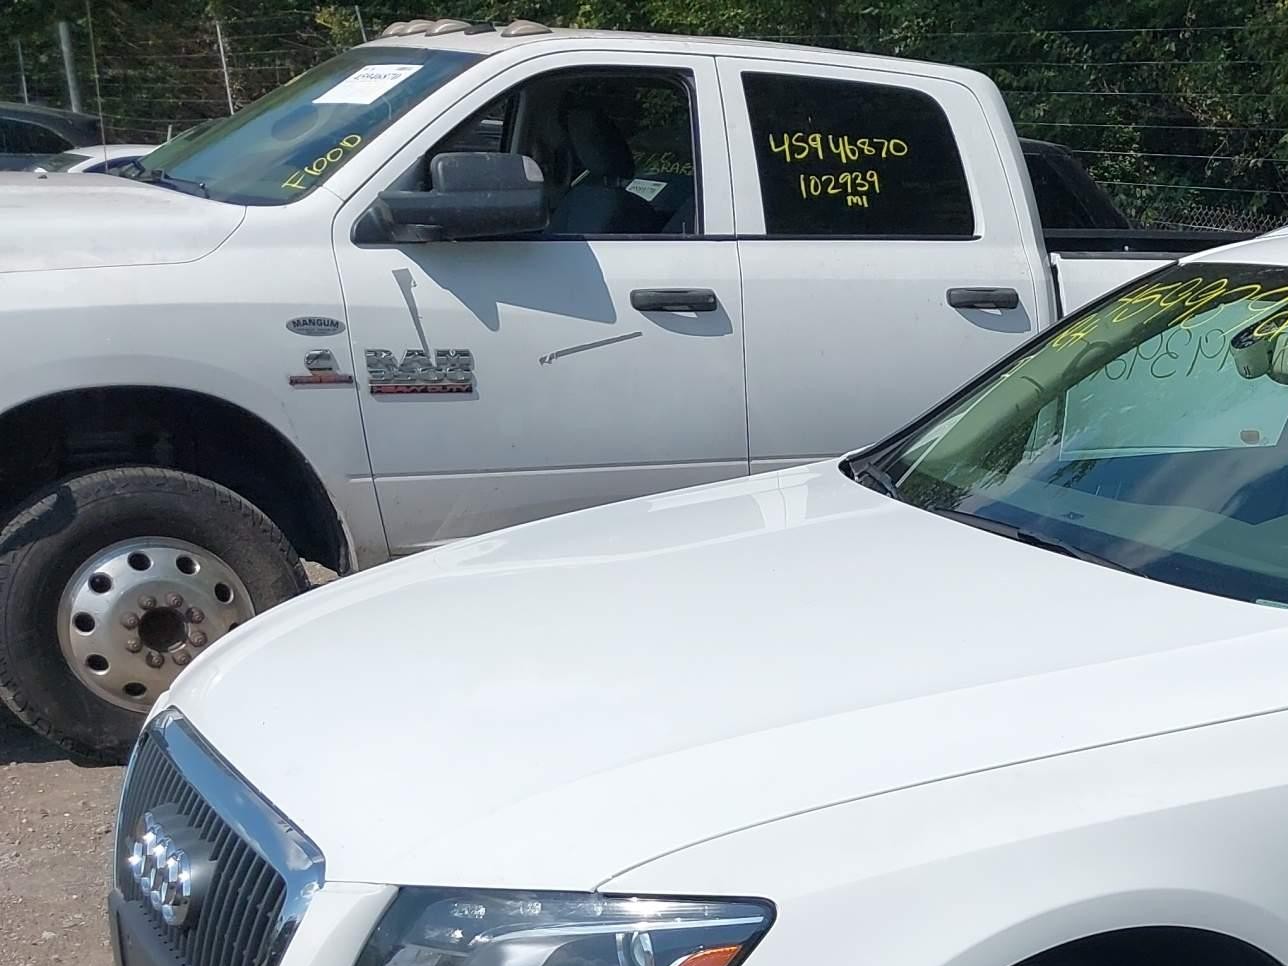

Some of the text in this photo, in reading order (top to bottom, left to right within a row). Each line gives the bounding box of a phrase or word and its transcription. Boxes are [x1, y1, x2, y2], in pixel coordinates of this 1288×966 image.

[769, 133, 908, 163] 45946870
[800, 170, 880, 199] 102939
[291, 319, 339, 328] MANGUM
[364, 349, 474, 370] RAM
[429, 384, 471, 393] DUTY
